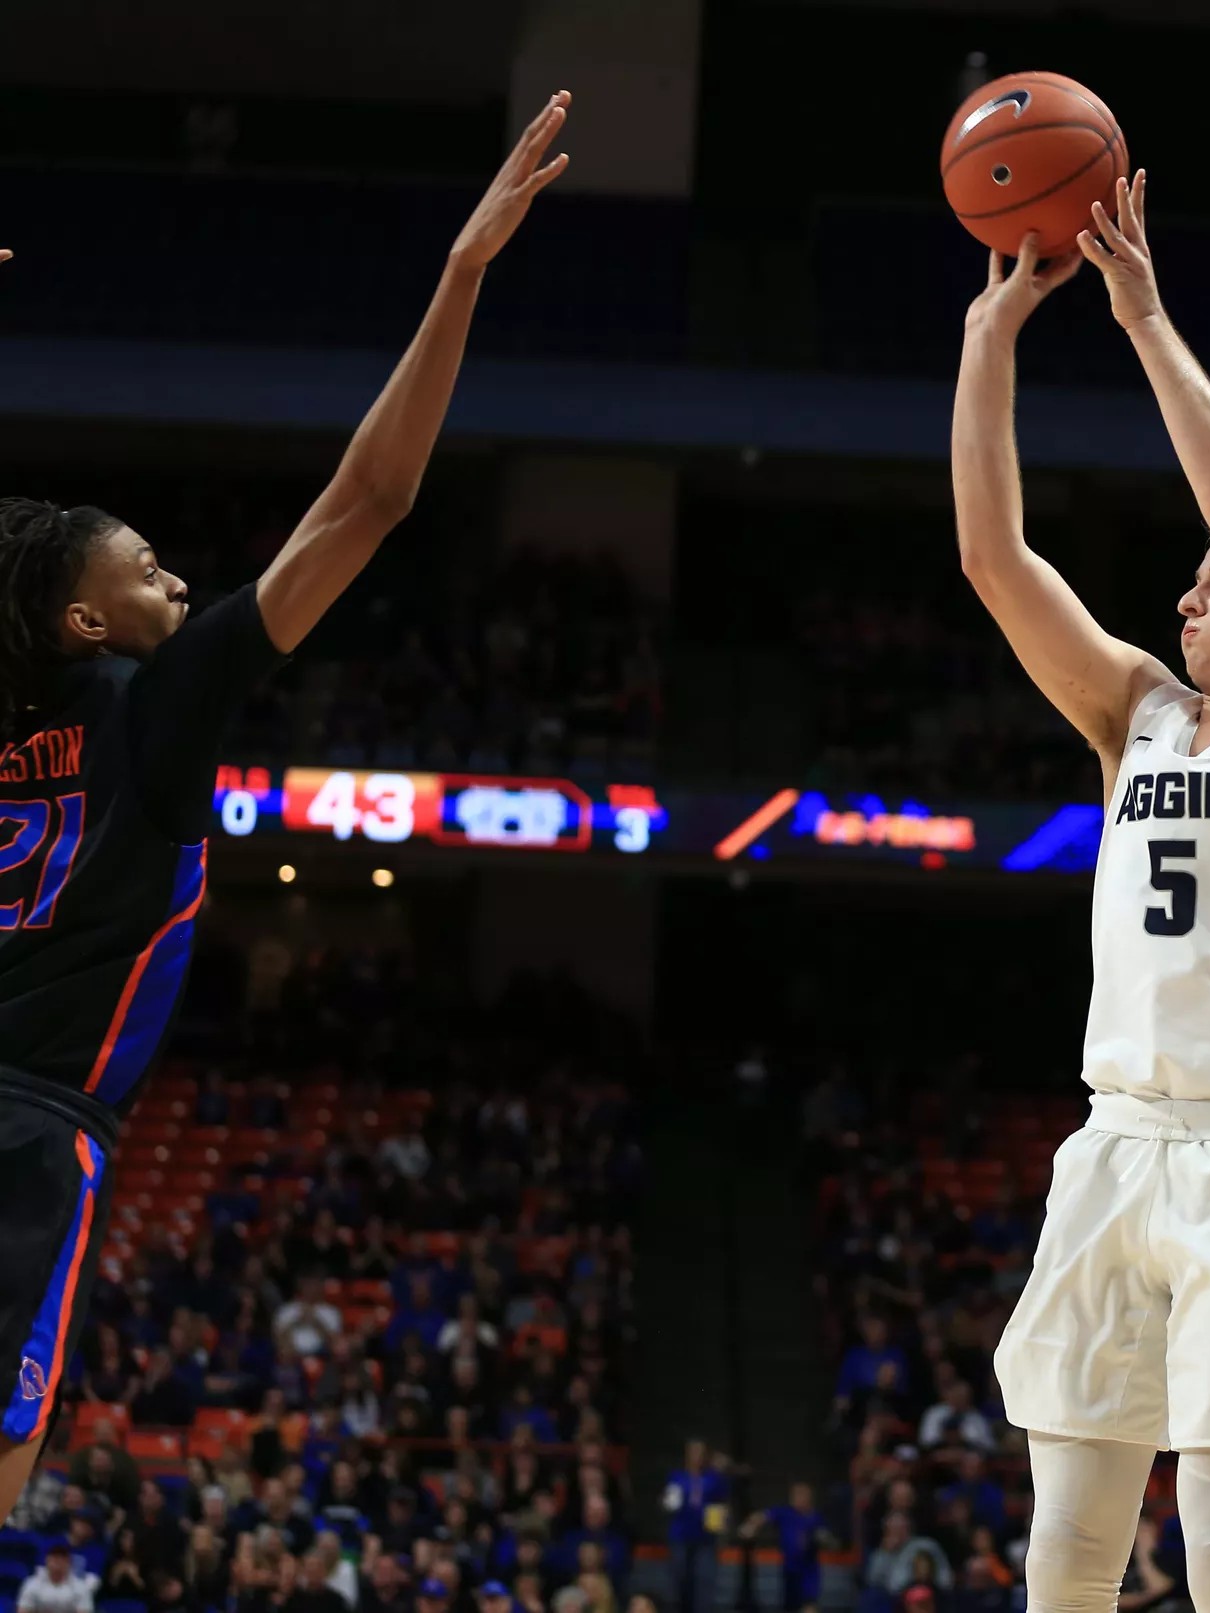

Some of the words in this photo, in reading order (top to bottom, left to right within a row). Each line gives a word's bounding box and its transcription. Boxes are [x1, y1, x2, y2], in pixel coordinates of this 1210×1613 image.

[221, 790, 257, 836] 0
[306, 771, 415, 843] 43
[0, 791, 86, 930] 21
[1144, 838, 1198, 938] 5
